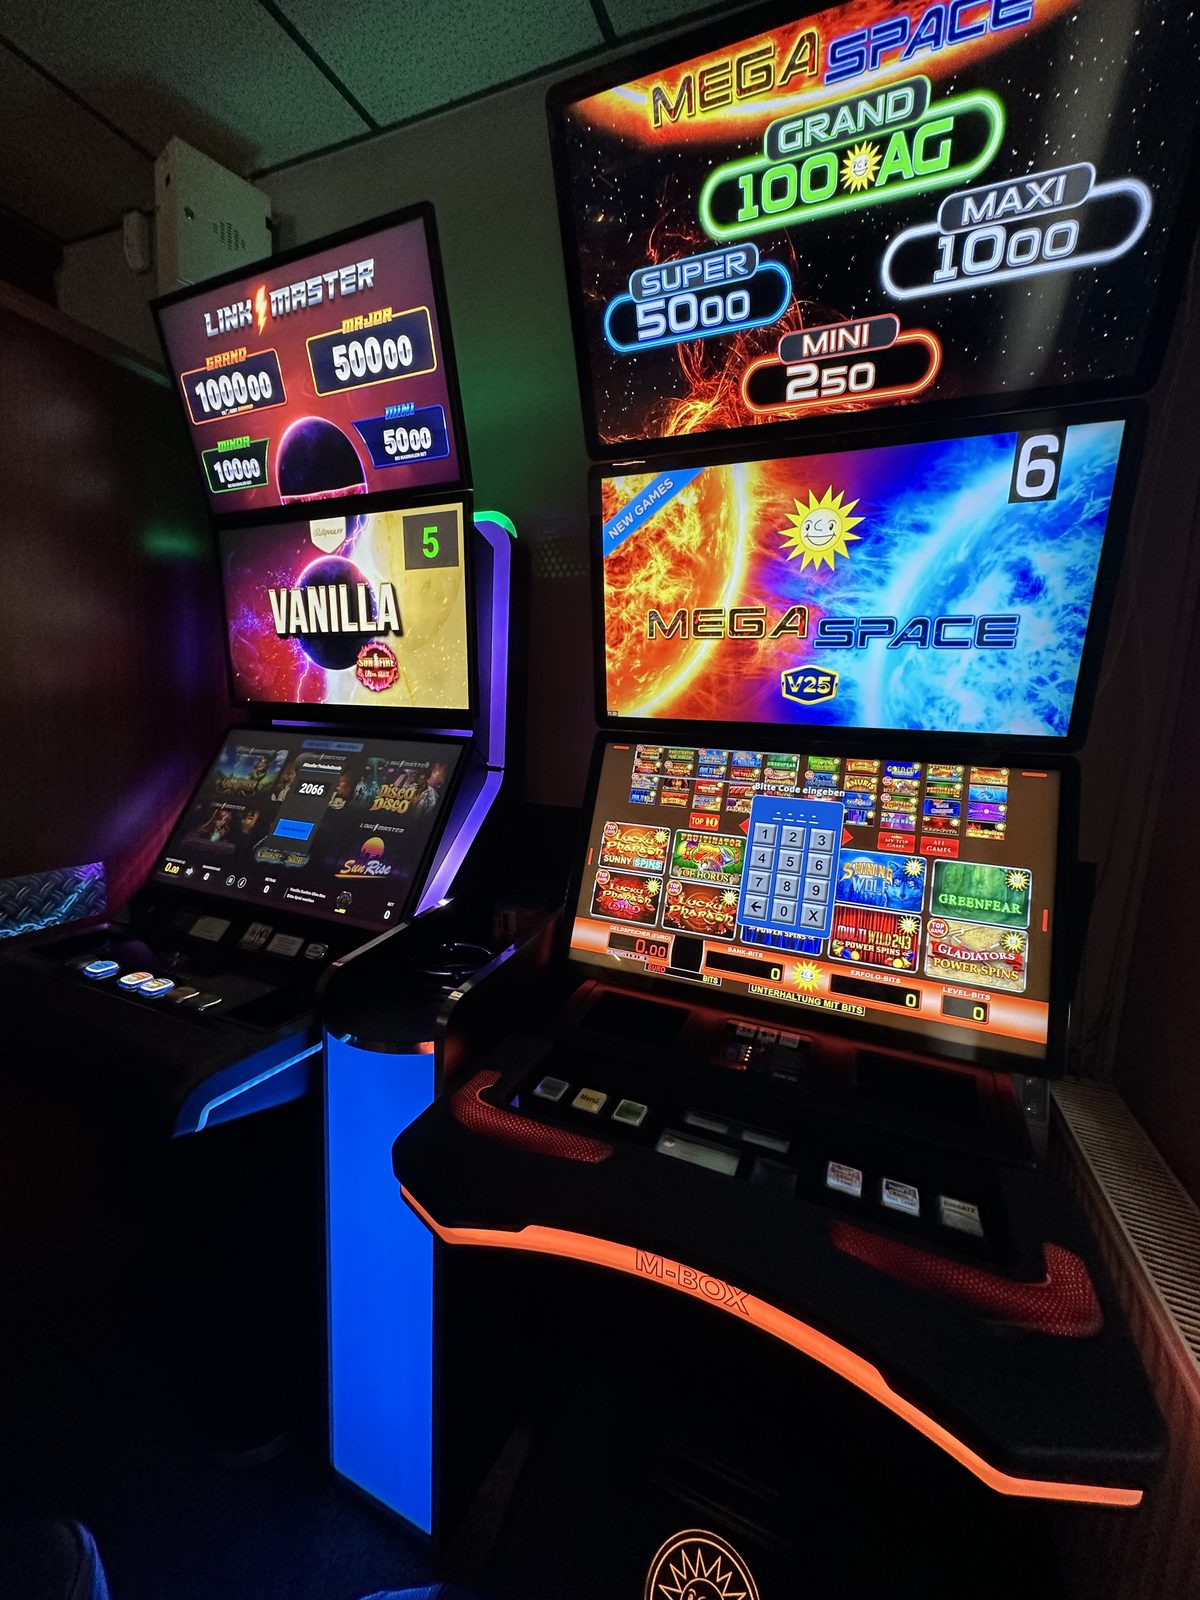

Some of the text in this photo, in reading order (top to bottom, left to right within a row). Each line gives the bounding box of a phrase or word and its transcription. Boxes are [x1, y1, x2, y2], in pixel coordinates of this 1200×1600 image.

[652, 0, 1035, 128] MEGA SPACE
[776, 88, 915, 152] GRAND
[738, 117, 955, 222] 100 AG
[961, 174, 1067, 227] MAXI
[932, 219, 1080, 284] 1000
[640, 251, 747, 297] SUPER
[204, 258, 374, 337] LINK MASTER
[342, 307, 393, 334] MAJOR
[635, 289, 752, 342] 5000
[801, 324, 871, 358] MINI
[205, 347, 247, 371] GRAND
[332, 335, 413, 381] 50000
[785, 361, 876, 403] 250
[383, 426, 432, 456] 5000
[1015, 434, 1060, 498] 6
[608, 478, 673, 539] NEW GAMES
[422, 525, 440, 559] 5
[268, 582, 401, 636] VANILLA
[647, 605, 1021, 649] MEGA SPACE
[786, 674, 832, 695] V25
[299, 782, 325, 796] 2066
[754, 782, 777, 792] Bitte
[778, 783, 801, 793] Code
[803, 786, 845, 797] eingeben
[846, 779, 877, 790] ANURIS
[691, 815, 719, 826] TOP 10
[680, 832, 742, 848] FRUITINATOR
[762, 829, 826, 846] 1 2 3
[604, 854, 662, 869] SUNNY SPINS
[758, 853, 823, 871] 4 5 6
[203, 872, 210, 881] 0
[697, 870, 730, 883] HORUS
[843, 862, 892, 885] SHINING
[263, 884, 270, 894] 0
[756, 877, 820, 896] 7 8 9
[852, 877, 890, 895] WOLF
[938, 893, 1022, 915] GREENFEAR
[383, 909, 391, 919] 0
[780, 906, 818, 922] 0 X
[609, 925, 651, 937] GELDSPEICHER
[931, 921, 945, 929] TOP
[931, 927, 945, 935] GAME
[635, 939, 666, 957] 0.00
[844, 941, 901, 957] POWER SPINS
[867, 930, 892, 947] WILD
[892, 934, 911, 950] 243
[727, 947, 764, 958] BANK-BITS
[937, 944, 1016, 962] GLADIATORS
[647, 963, 666, 973] EURO
[770, 968, 781, 981] 0
[850, 969, 902, 985] ERFOLG-BITS
[933, 957, 1019, 981] POWER SPINS
[702, 974, 719, 984] BITS
[750, 984, 864, 1015] UNTERHALTUNG MIT BITS
[905, 993, 917, 1007] 0
[942, 986, 991, 1002] LEVEL-BITS
[972, 1006, 984, 1021] 0
[580, 1093, 600, 1104] Menü
[635, 1248, 749, 1316] M-BOX
